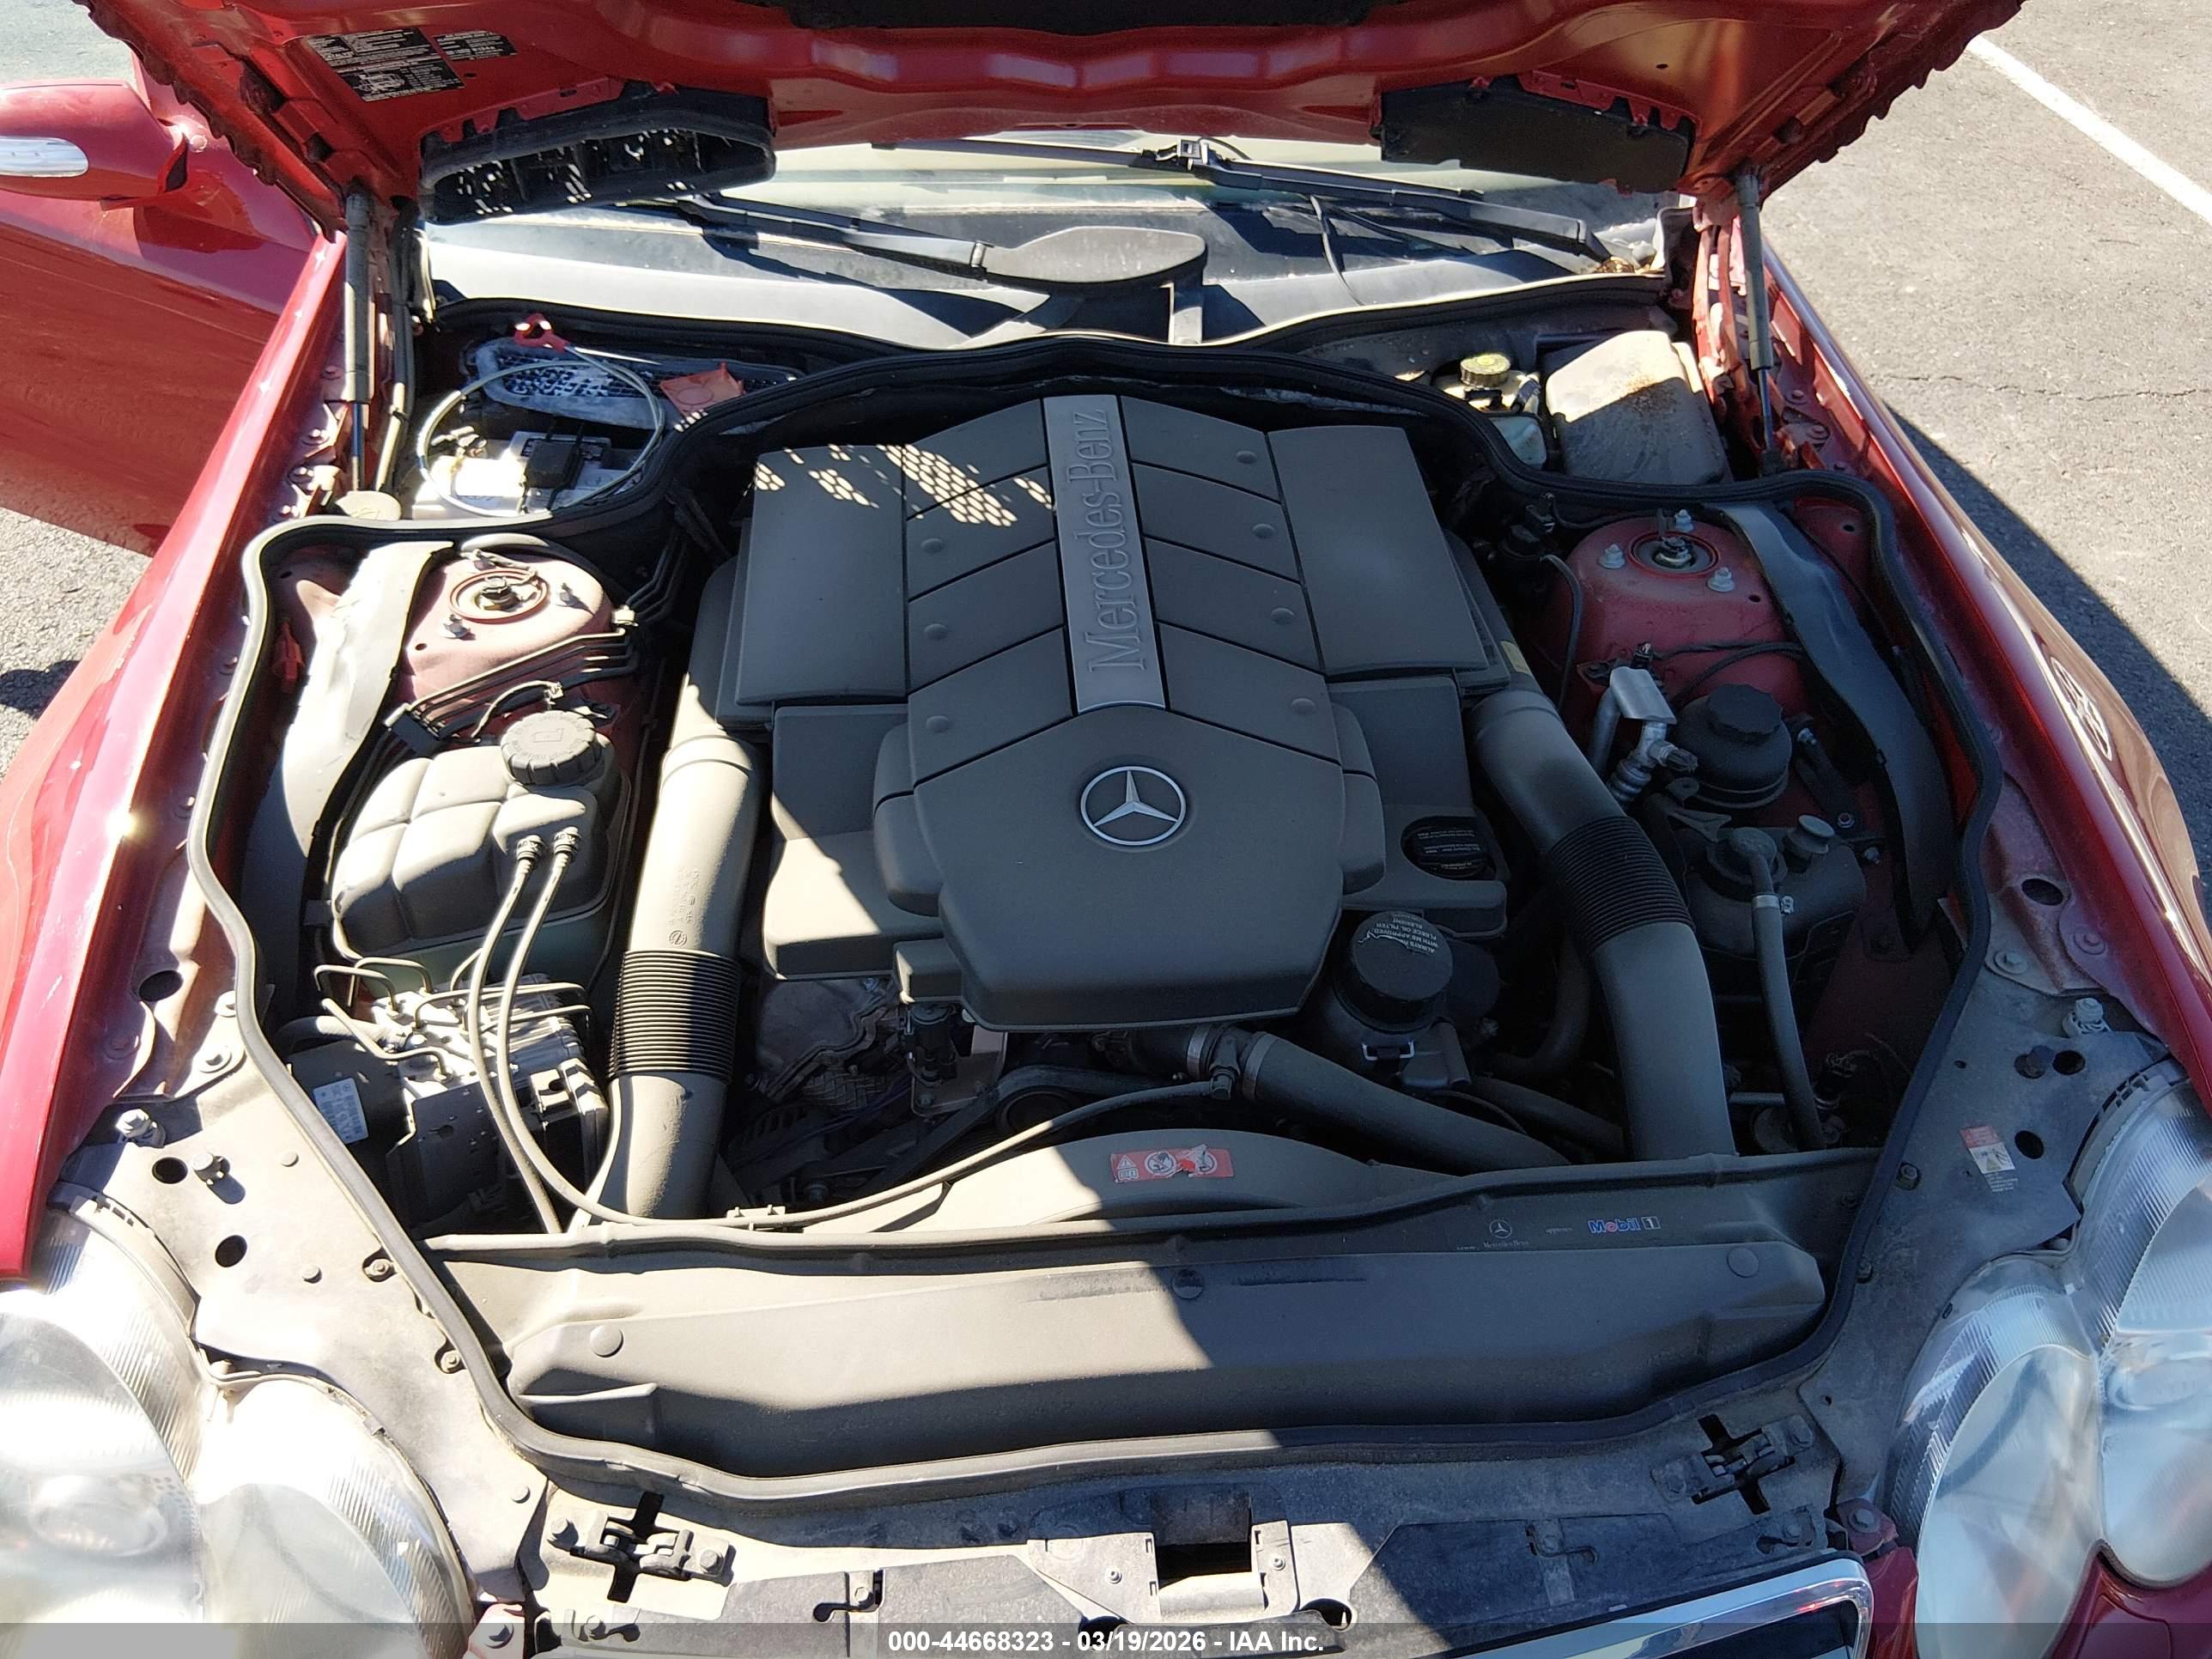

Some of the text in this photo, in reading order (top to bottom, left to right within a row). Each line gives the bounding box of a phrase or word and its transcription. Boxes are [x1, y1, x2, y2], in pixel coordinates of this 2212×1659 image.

[1066, 408, 1147, 673] Mercedes-Benz
[1409, 941, 1435, 952] ALWAYS
[1422, 938, 1438, 948] WITH
[1588, 1218, 1641, 1234] Mobil
